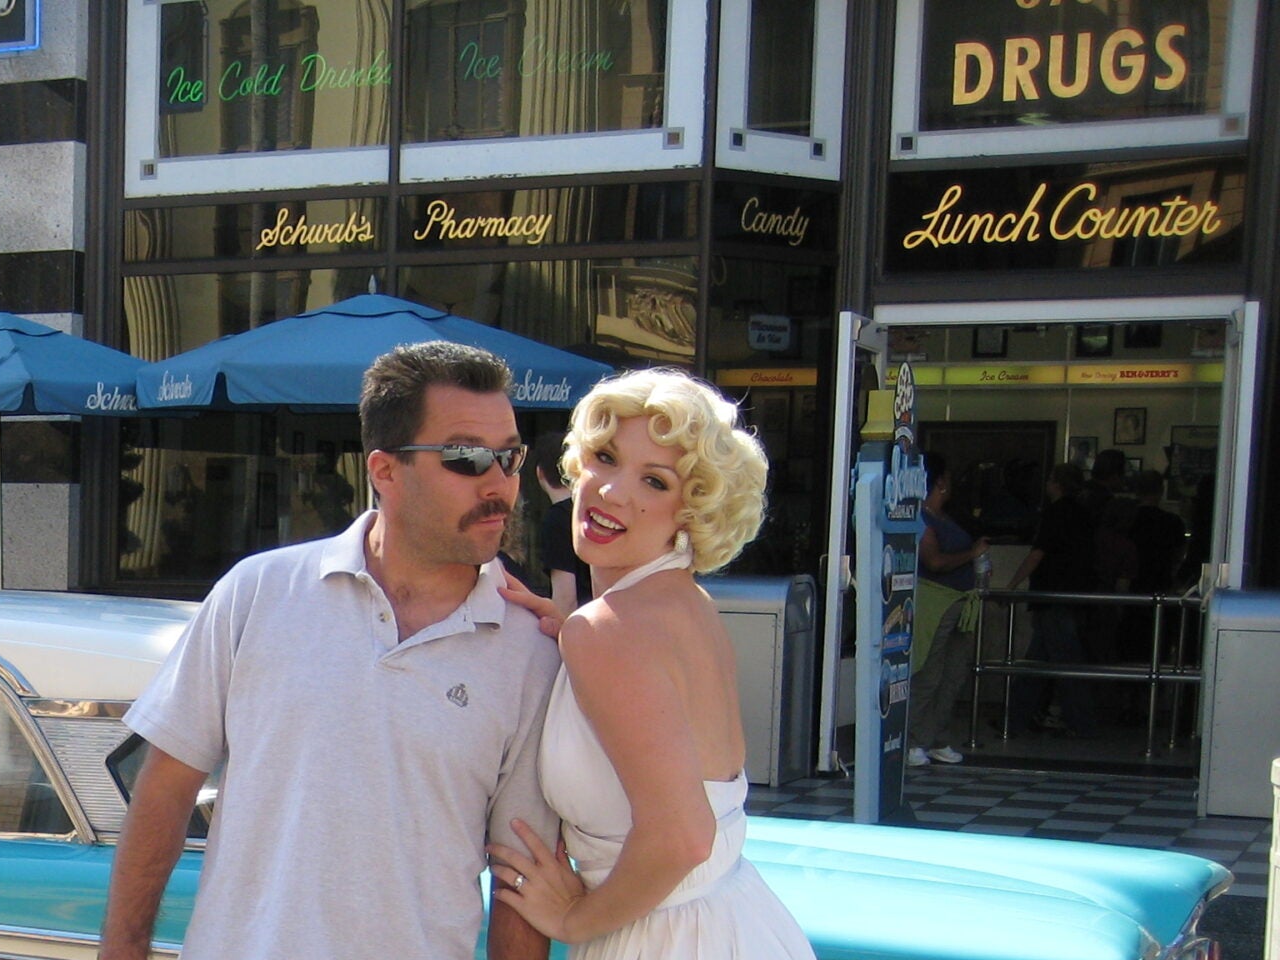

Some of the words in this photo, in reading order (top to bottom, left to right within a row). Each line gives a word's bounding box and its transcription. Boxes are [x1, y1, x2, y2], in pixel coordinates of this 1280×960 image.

[167, 66, 204, 103] Ice
[218, 60, 286, 101] Cold
[299, 50, 392, 92] Drinks
[459, 41, 503, 80] Ice
[952, 24, 1187, 106] DRUGS
[256, 207, 375, 251] Schwab's
[414, 200, 553, 245] Pharmacy
[740, 198, 810, 246] Candy
[902, 183, 1047, 250] Lunch
[1049, 182, 1222, 242] Counter
[979, 370, 996, 382] Ice
